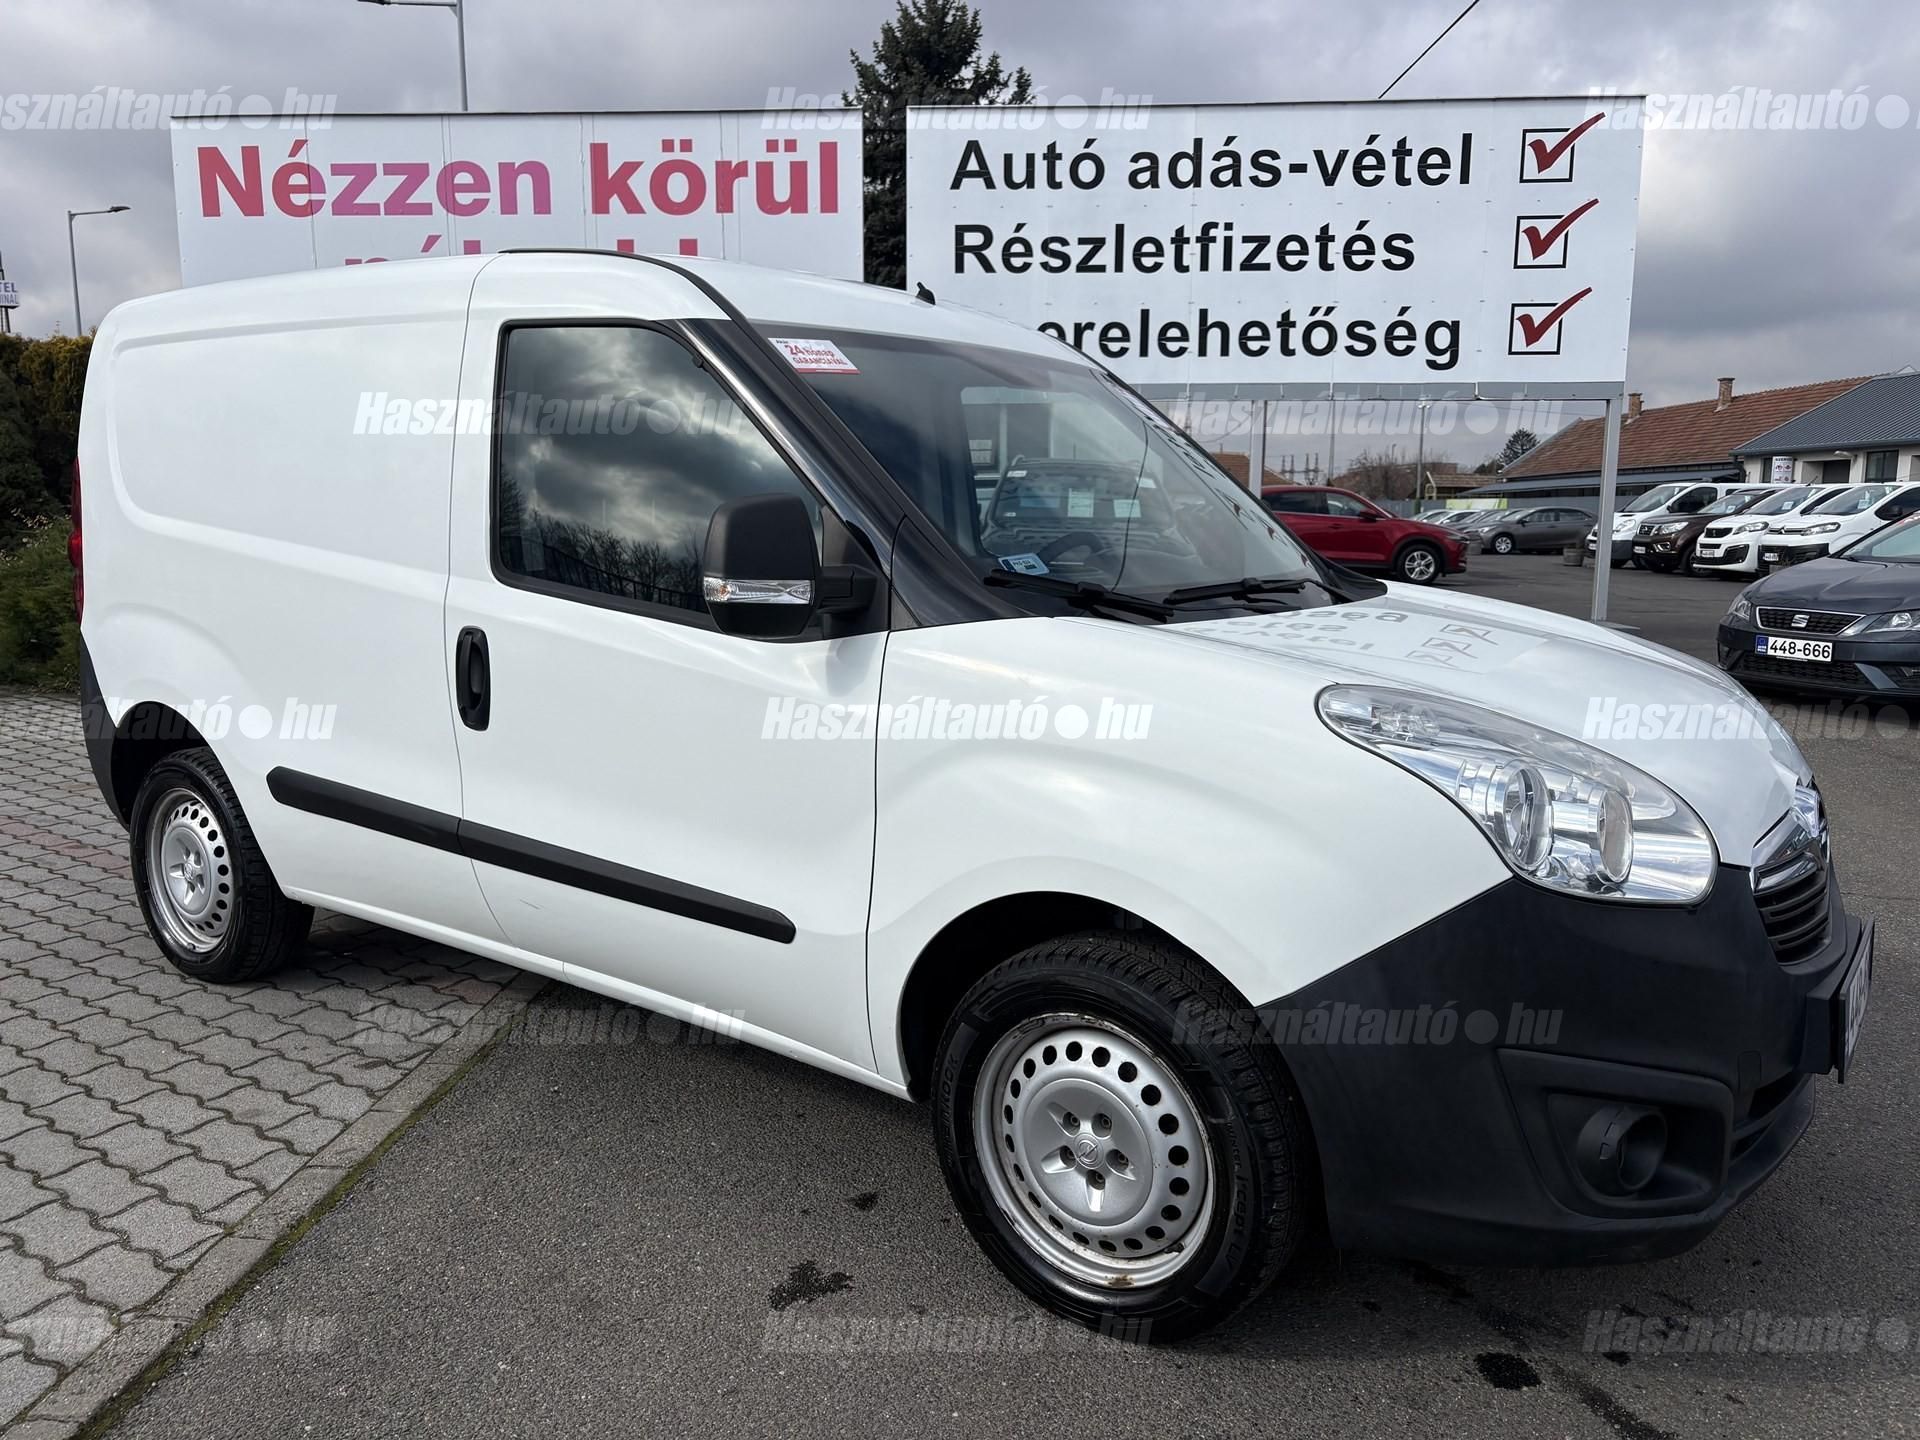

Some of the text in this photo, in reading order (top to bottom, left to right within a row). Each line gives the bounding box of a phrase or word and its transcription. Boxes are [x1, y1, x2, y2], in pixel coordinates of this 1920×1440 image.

[197, 138, 839, 218] Nézzen körül
[949, 132, 1473, 190] Autó adás-vétel
[954, 220, 1415, 275] Részletfizetés
[1769, 639, 1831, 659] 448-666
